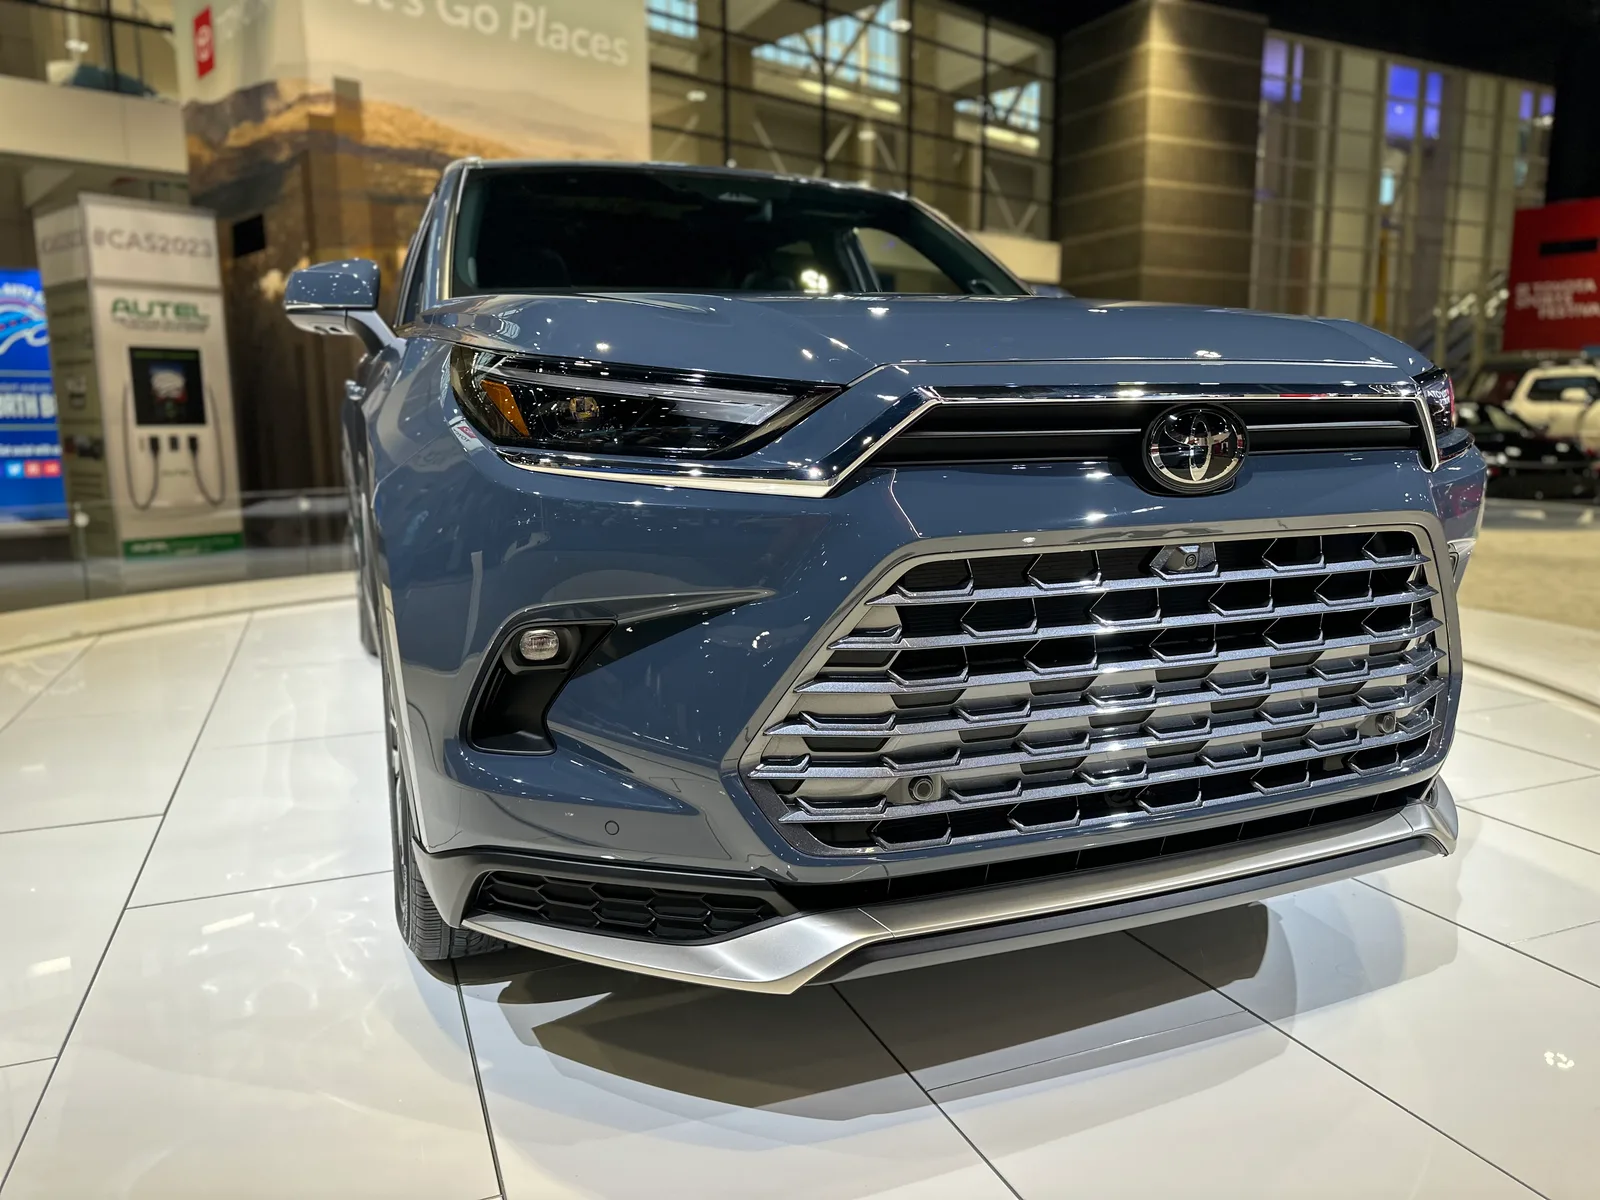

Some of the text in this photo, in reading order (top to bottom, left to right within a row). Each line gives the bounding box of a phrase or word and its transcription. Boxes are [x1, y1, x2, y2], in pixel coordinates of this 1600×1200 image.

[436, 0, 629, 67] Go Places
[93, 226, 213, 258] #CAS2023
[111, 297, 210, 322] AUTEL
